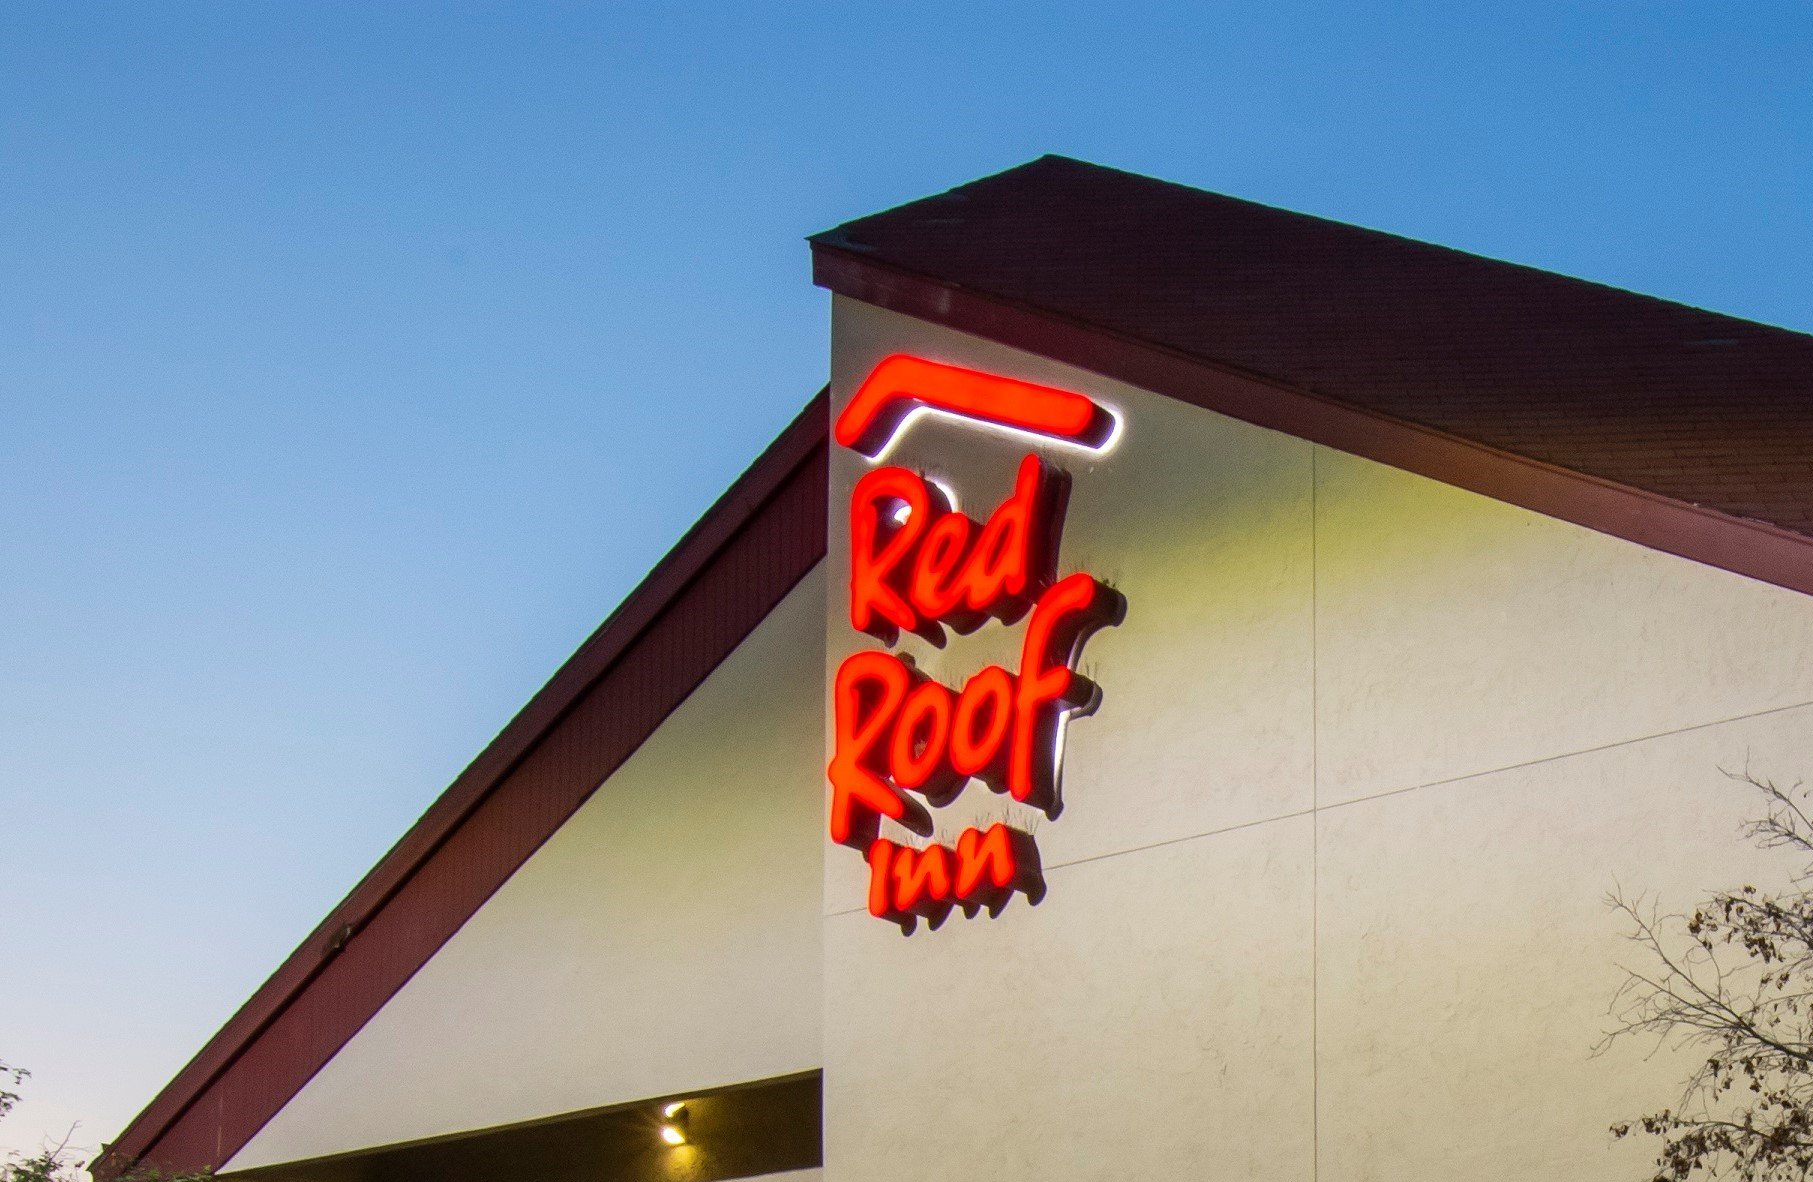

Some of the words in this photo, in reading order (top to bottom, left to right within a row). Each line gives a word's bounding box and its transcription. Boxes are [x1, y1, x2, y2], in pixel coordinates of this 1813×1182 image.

[850, 453, 1041, 632] Red
[828, 571, 1095, 844] Roof
[867, 822, 1016, 918] Inn
